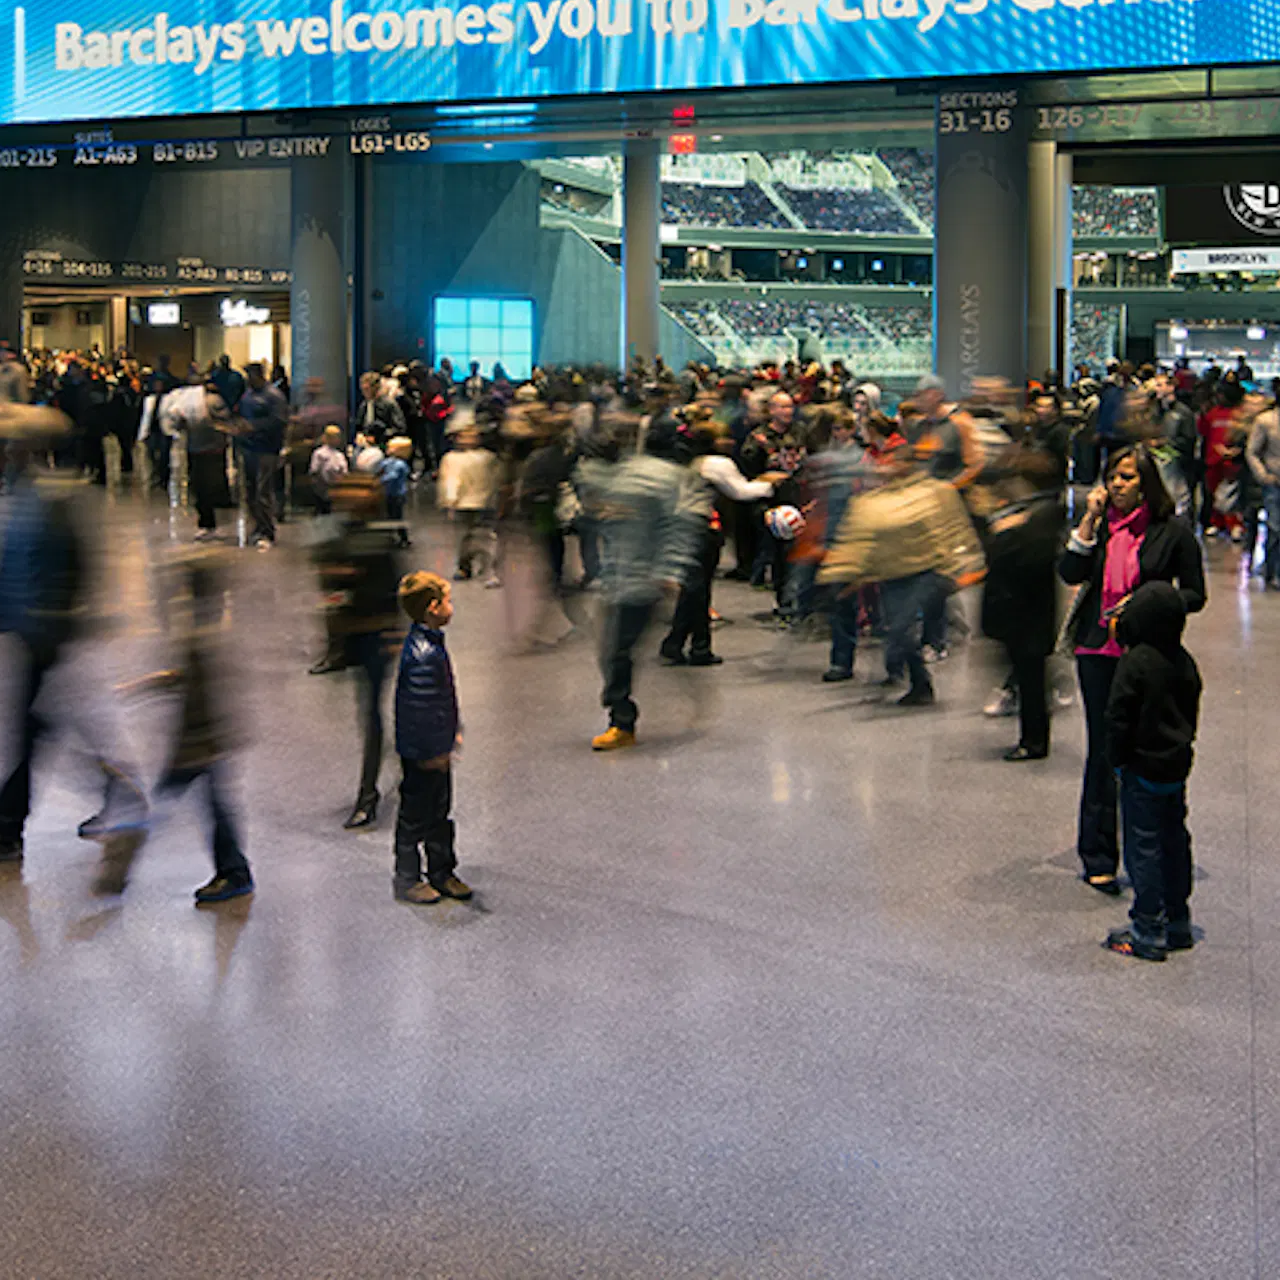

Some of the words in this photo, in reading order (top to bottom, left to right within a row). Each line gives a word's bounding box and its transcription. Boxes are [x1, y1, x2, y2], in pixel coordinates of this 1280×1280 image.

[55, 12, 245, 75] Barclays
[257, 0, 515, 58] welcomes
[939, 90, 1018, 108] SECTIONS
[350, 117, 391, 132] LOGES
[939, 109, 1012, 133] 31-16
[73, 145, 138, 165] A1-A63
[153, 142, 218, 162] B1-B15
[234, 139, 265, 159] VIP
[268, 136, 332, 158] ENTRY
[350, 132, 431, 154] LG1-LG5
[1207, 252, 1269, 265] BROOKLYN
